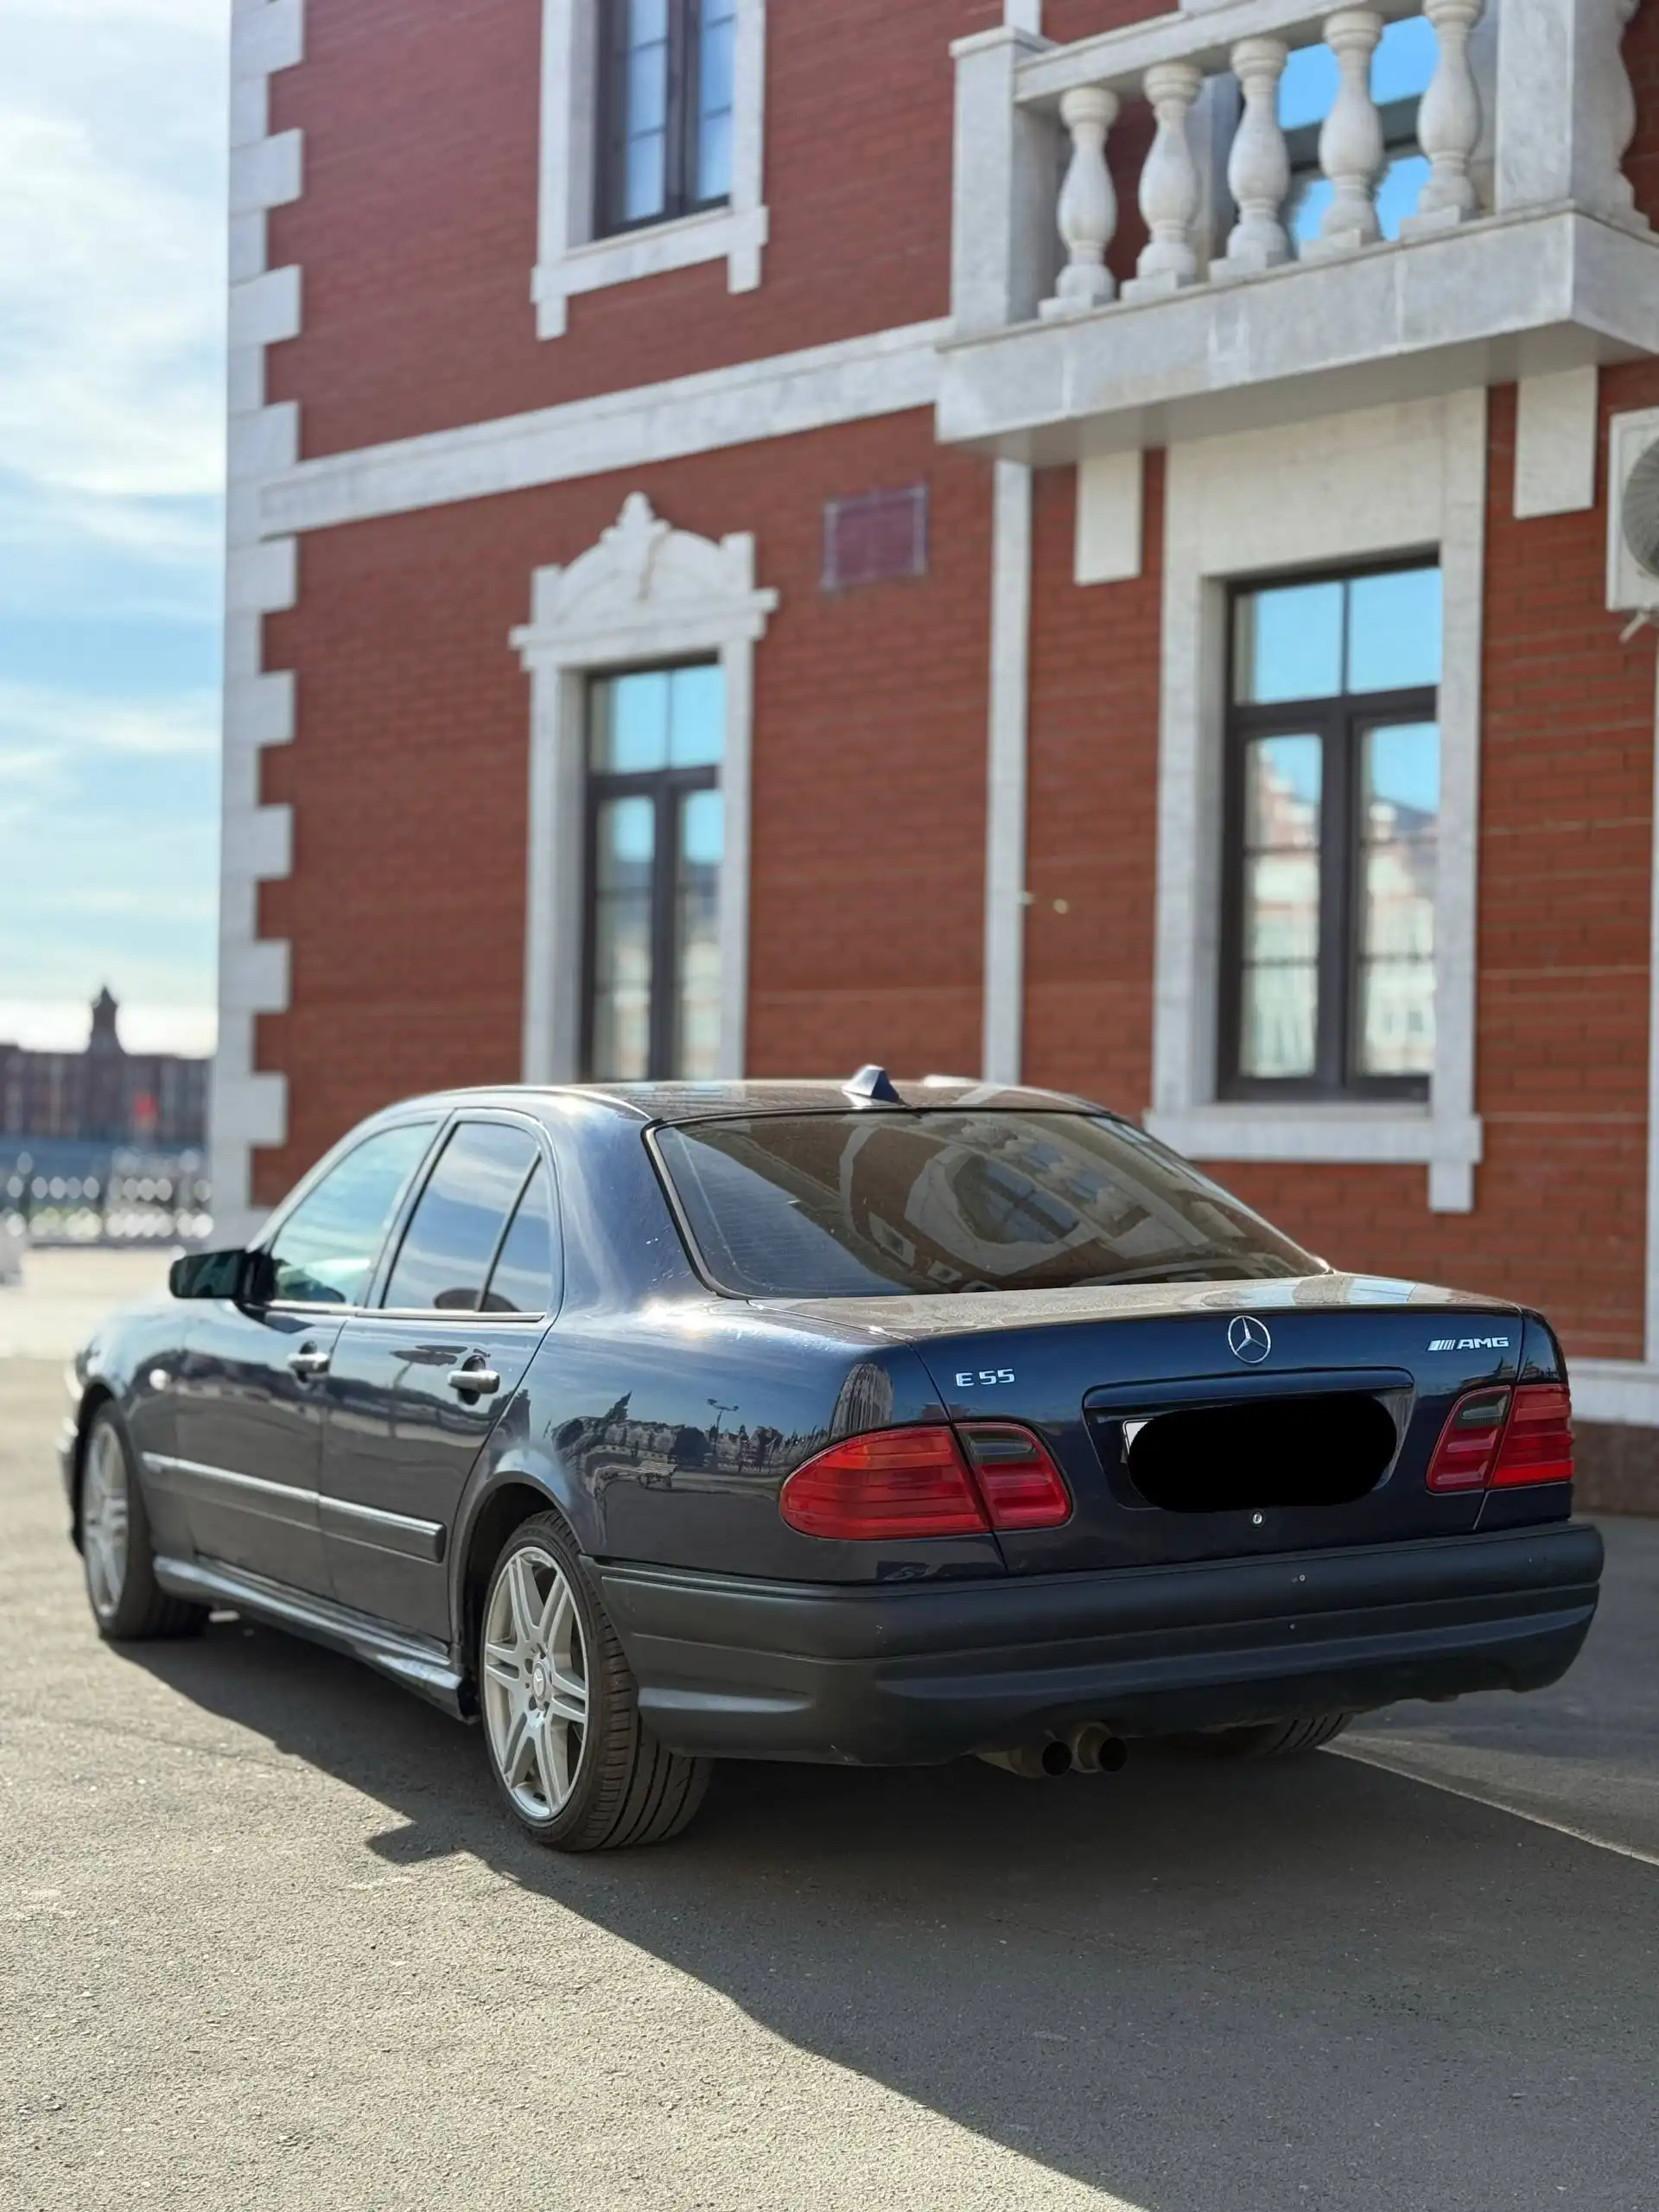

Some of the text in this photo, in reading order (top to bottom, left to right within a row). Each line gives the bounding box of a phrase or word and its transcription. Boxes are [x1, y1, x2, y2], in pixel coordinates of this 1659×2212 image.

[1456, 1337, 1510, 1350] AMG
[956, 1368, 1015, 1387] E 55
